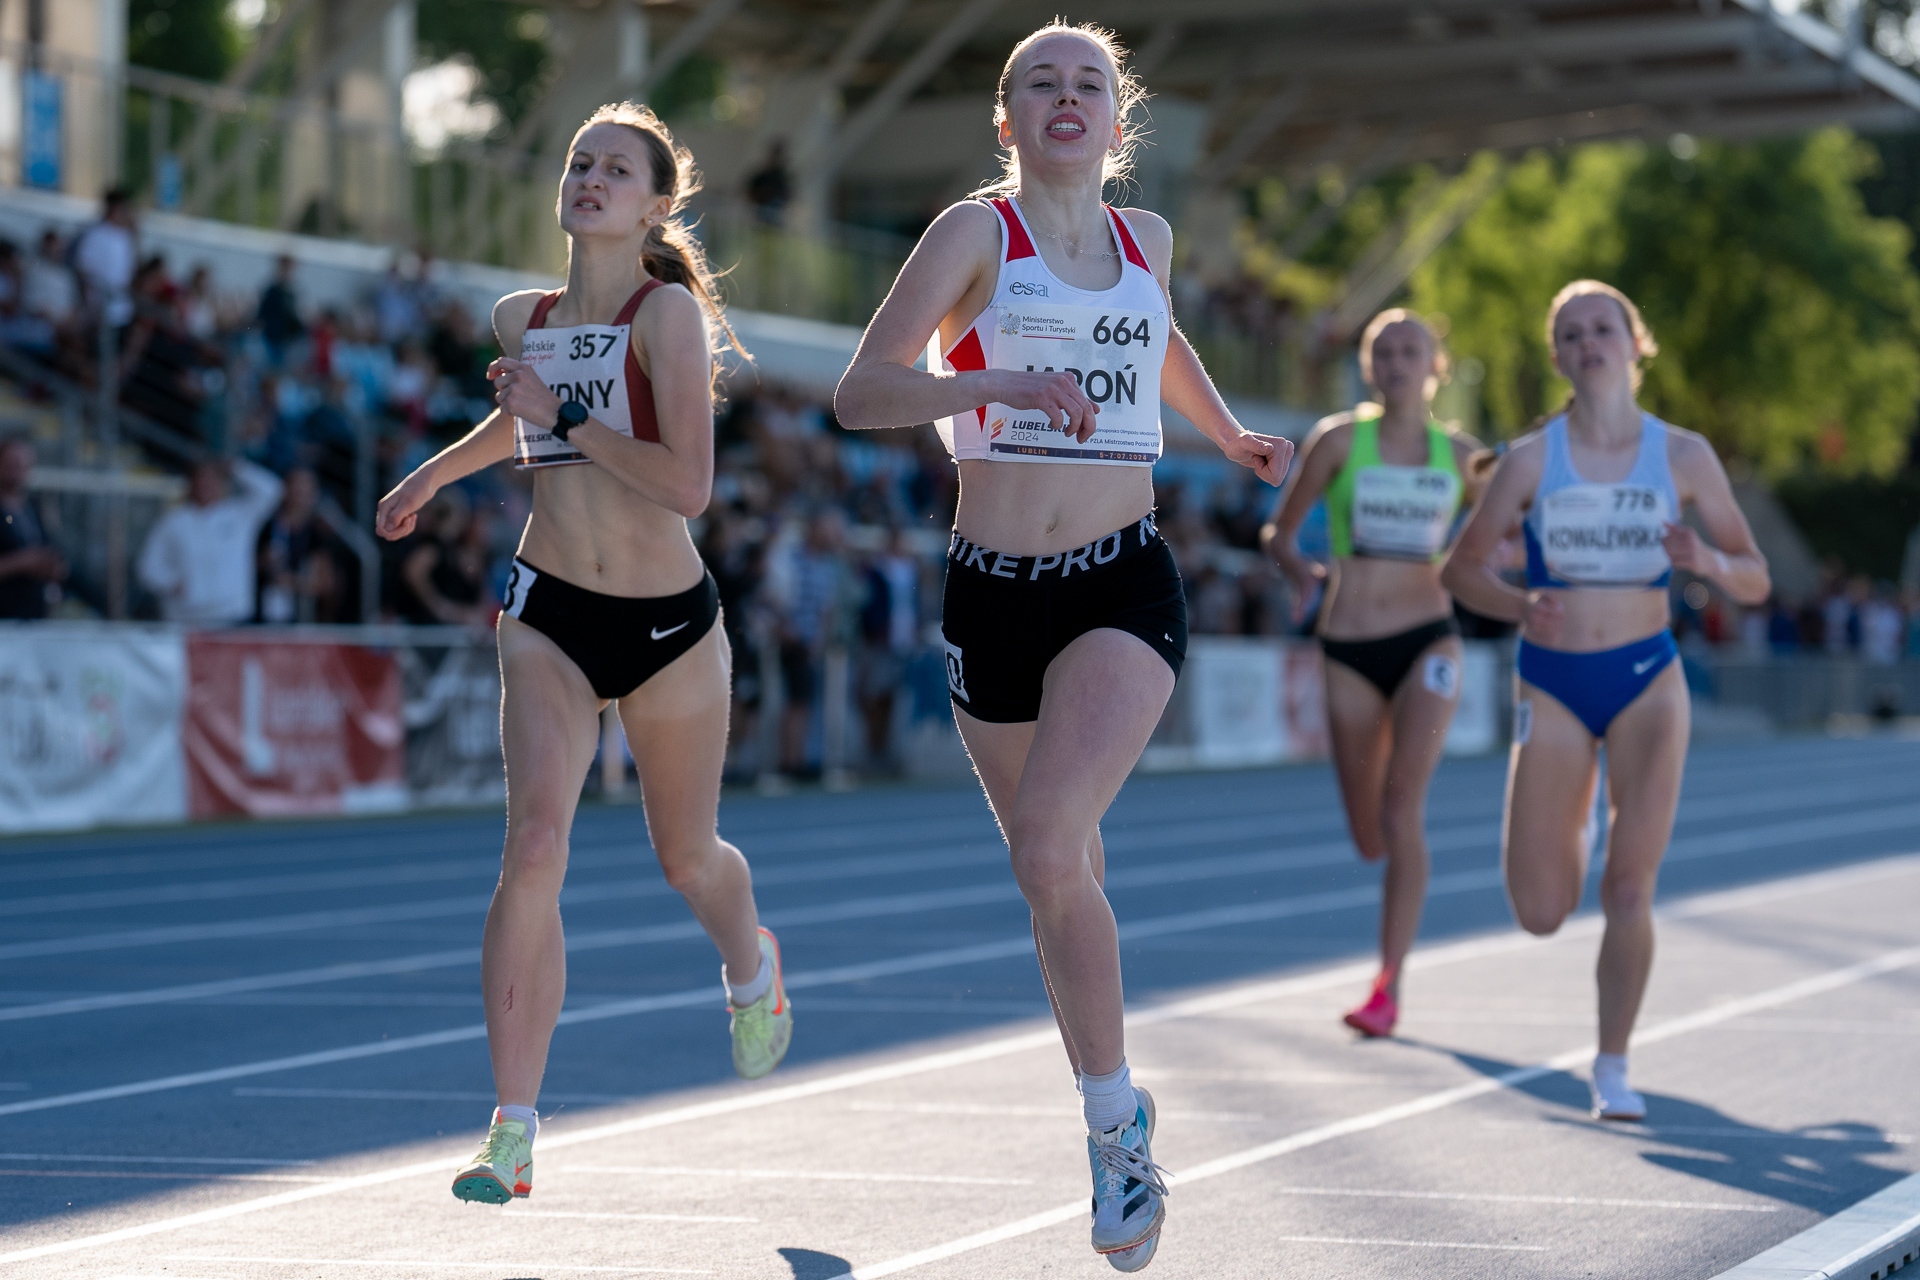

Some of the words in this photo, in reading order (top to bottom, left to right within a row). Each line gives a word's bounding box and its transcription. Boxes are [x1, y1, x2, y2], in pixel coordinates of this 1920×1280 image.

[1021, 323, 1043, 333] Sportu
[1049, 325, 1076, 334] Turystyki
[1022, 315, 1064, 325] Ministerstwo
[1092, 315, 1150, 347] 664
[569, 333, 617, 360] 357
[549, 379, 615, 409] DNY
[1010, 431, 1039, 441] 2024
[1017, 447, 1048, 455] LUBLIN
[1099, 451, 1147, 461] 5-7.07.2024
[1029, 530, 1121, 581] PRO
